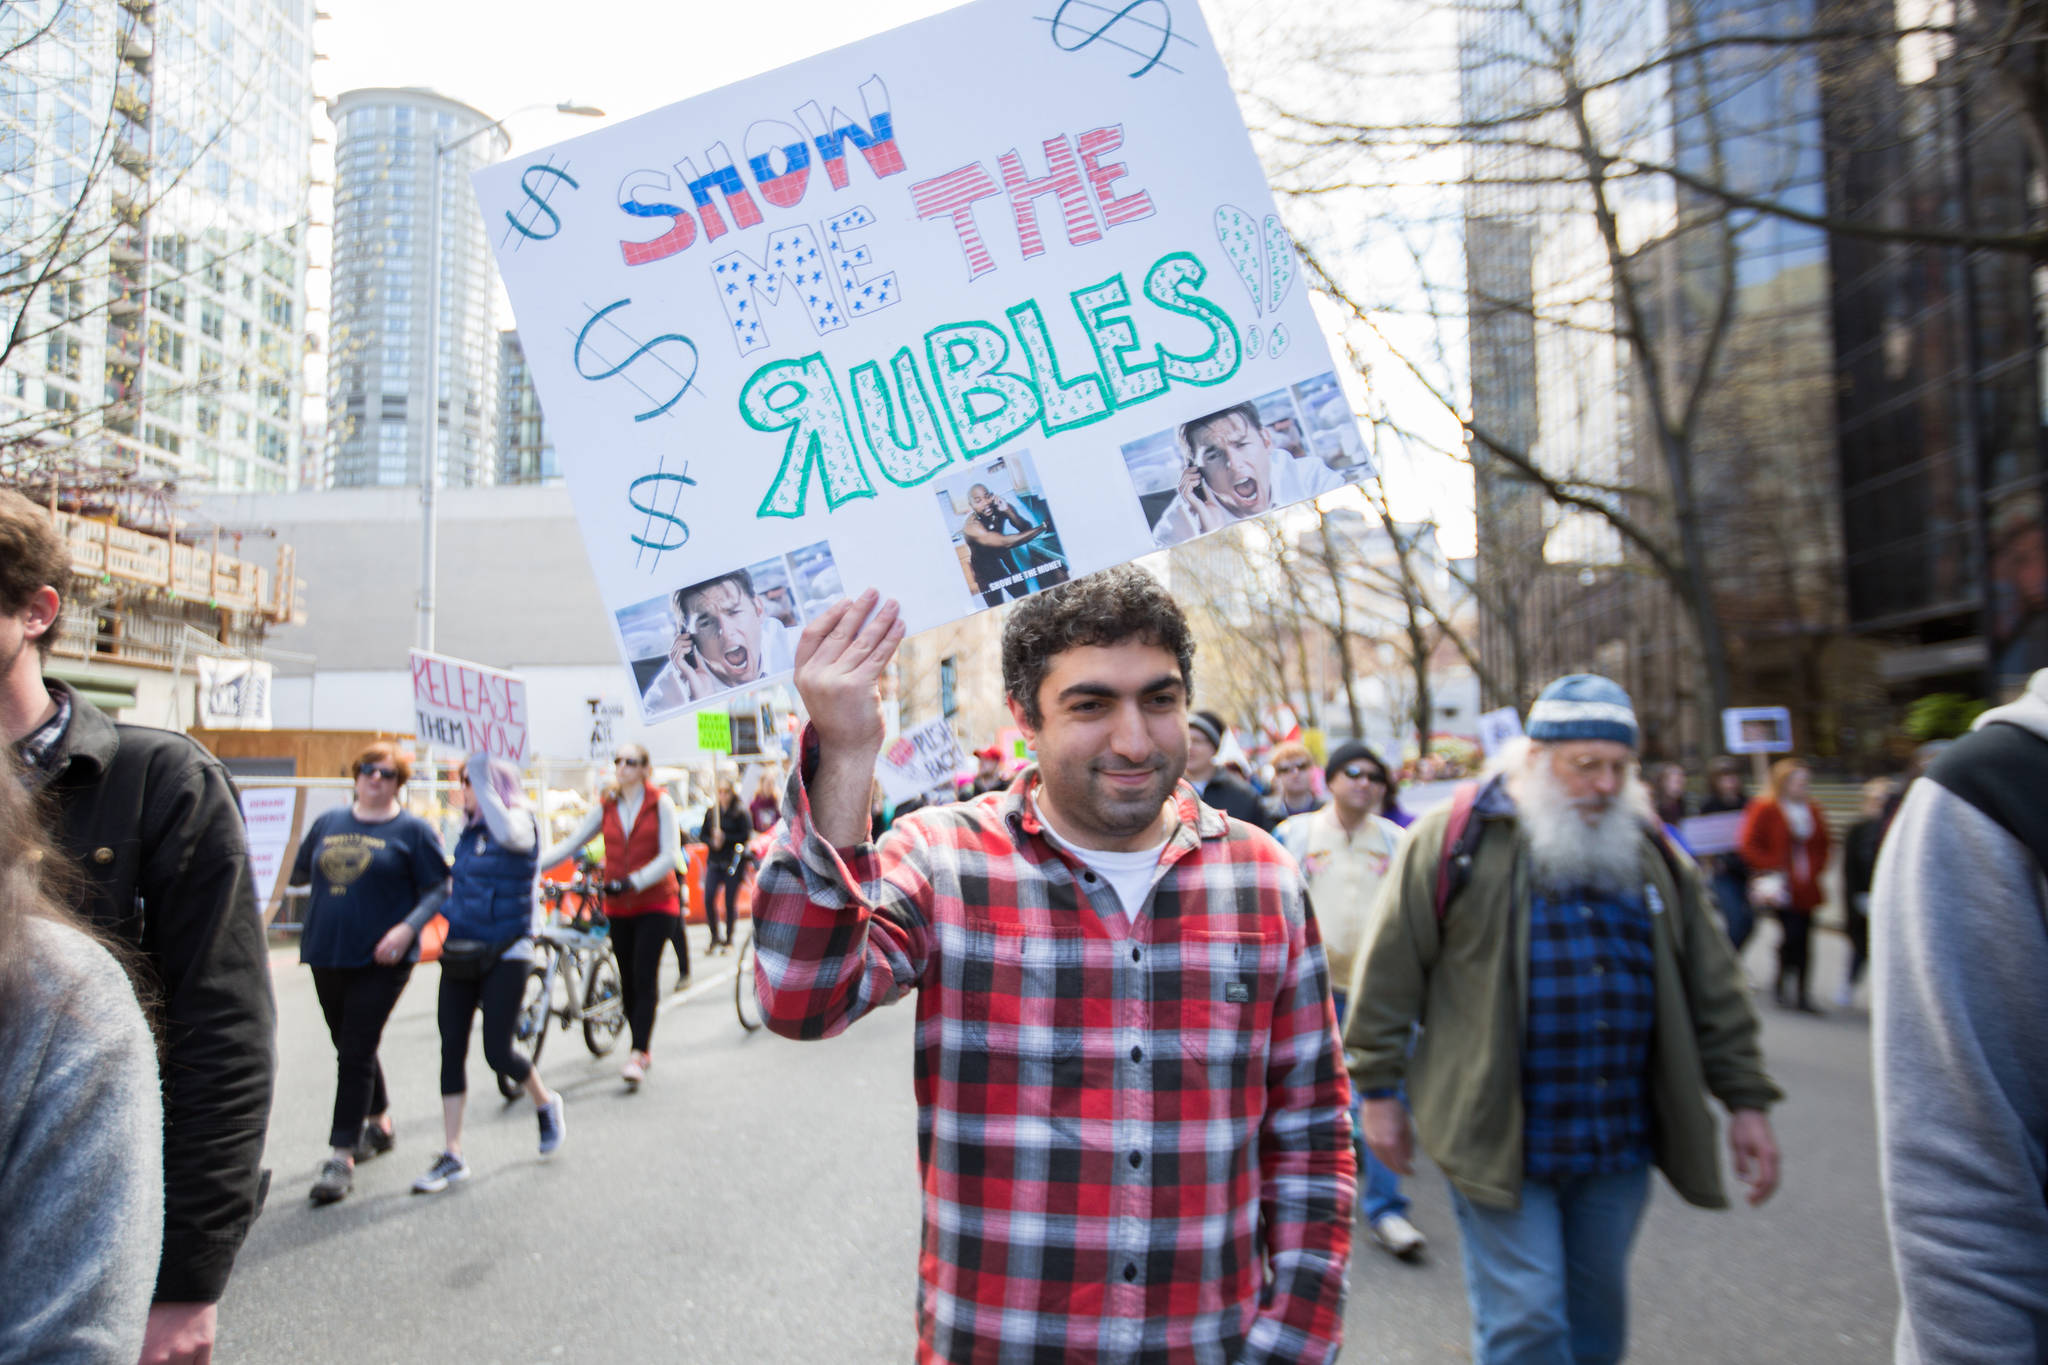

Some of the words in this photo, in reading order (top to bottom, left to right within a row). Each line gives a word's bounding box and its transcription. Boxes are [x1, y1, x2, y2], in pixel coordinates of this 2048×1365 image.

[618, 73, 907, 266] SHOW
[710, 204, 901, 357] ME
[907, 122, 1157, 282] THE
[1011, 572, 1025, 584] ME
[1022, 567, 1038, 580] THE
[1036, 559, 1063, 575] MONEY
[410, 653, 526, 728] RELEASE
[415, 709, 467, 750] THEM
[465, 716, 527, 761] NOW
